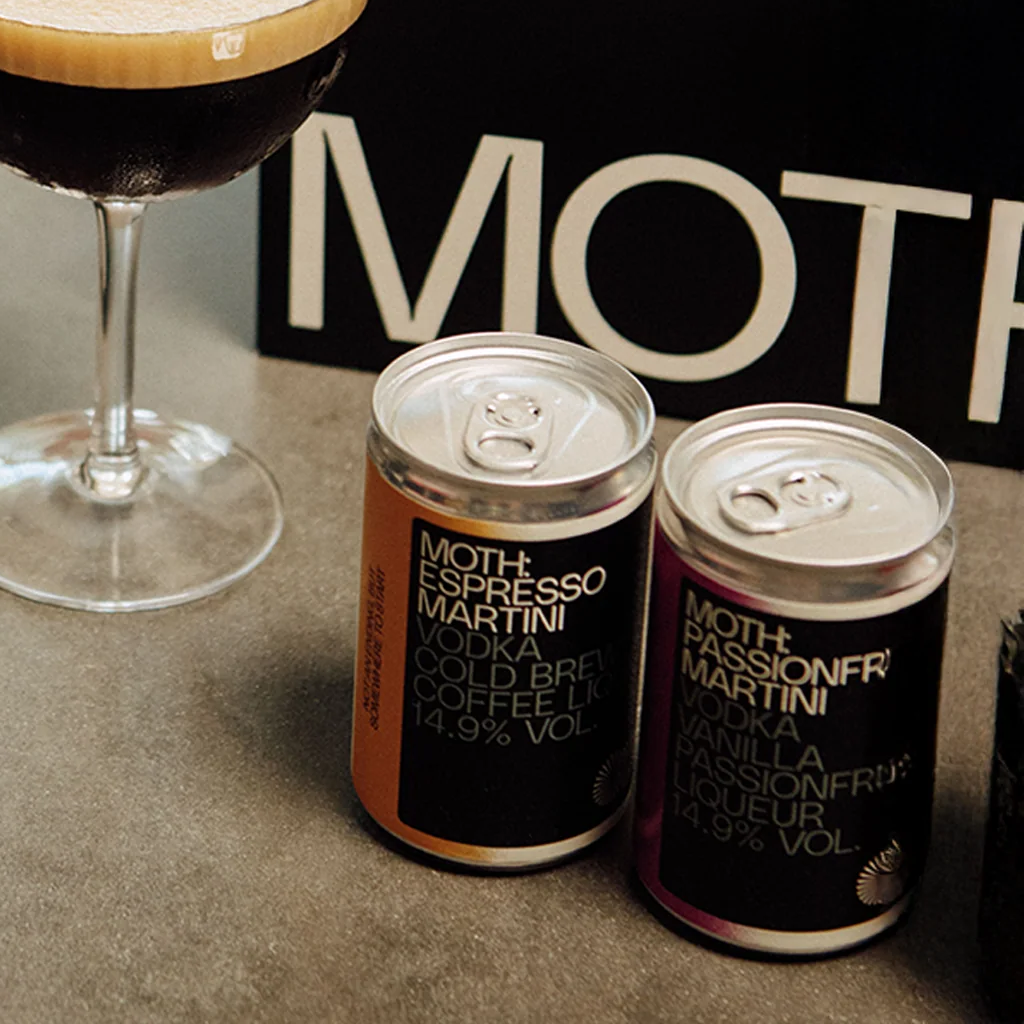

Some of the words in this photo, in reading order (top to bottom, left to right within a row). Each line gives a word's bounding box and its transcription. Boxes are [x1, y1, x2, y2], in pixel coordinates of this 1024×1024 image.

[421, 530, 532, 577] MOTH:
[419, 559, 607, 606] ESPRESSO
[418, 590, 566, 634] MARTINI
[685, 589, 792, 655] MOTH:
[416, 616, 543, 662] VODKA
[414, 647, 517, 690] COLD
[681, 648, 828, 716] MARTINI
[413, 674, 556, 719] COFFEE
[679, 676, 801, 743] VODKA
[412, 698, 512, 746] 14.9%
[526, 710, 598, 744] VOL.
[678, 704, 824, 773] VANILLA
[673, 761, 825, 829] LIQUEUR
[672, 792, 765, 852] 14.9%
[778, 828, 862, 857] VOL.
